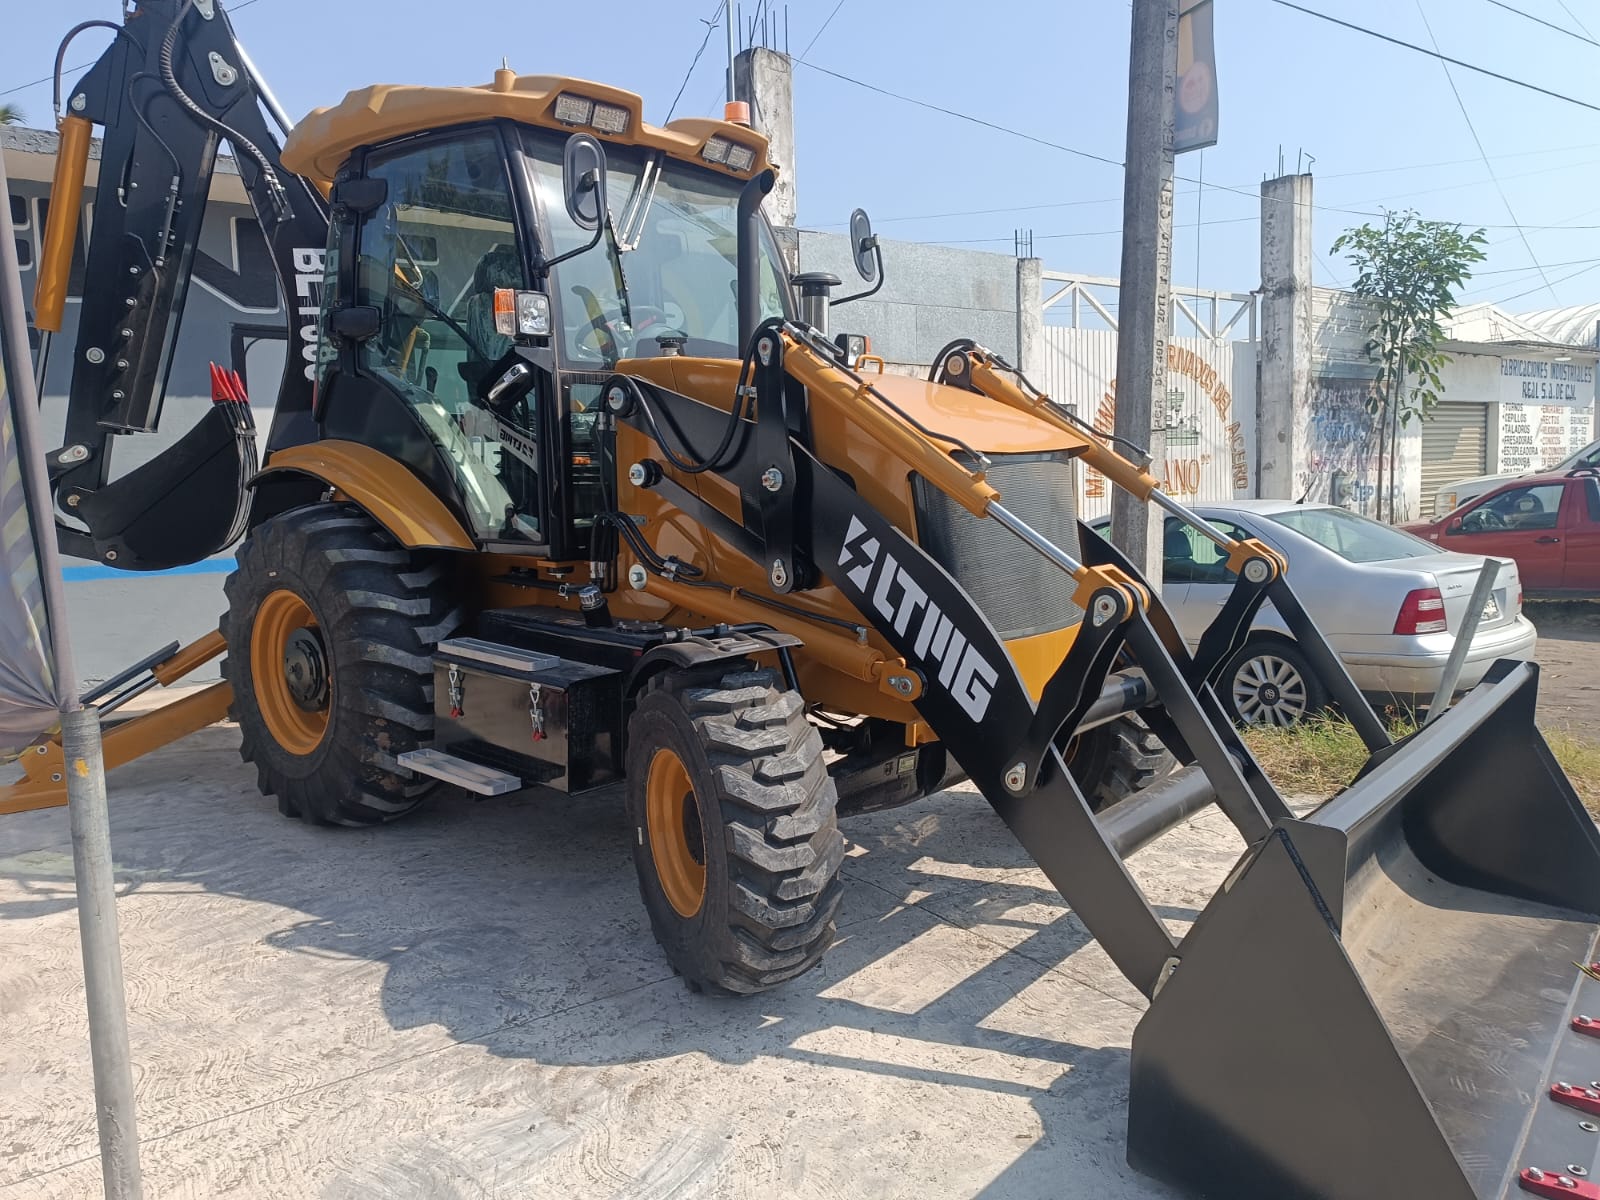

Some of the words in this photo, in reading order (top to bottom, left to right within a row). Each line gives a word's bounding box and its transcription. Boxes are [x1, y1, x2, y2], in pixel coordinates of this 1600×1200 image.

[1501, 358, 1548, 379] FABRICACIONES
[1550, 362, 1592, 384] INDUSTRIALES
[1522, 381, 1539, 399] REAL
[1505, 412, 1527, 423] CEPILLOS
[1505, 423, 1530, 434] TALADROS
[1504, 435, 1533, 445] FRESADORAS
[1226, 420, 1249, 490] ACERO
